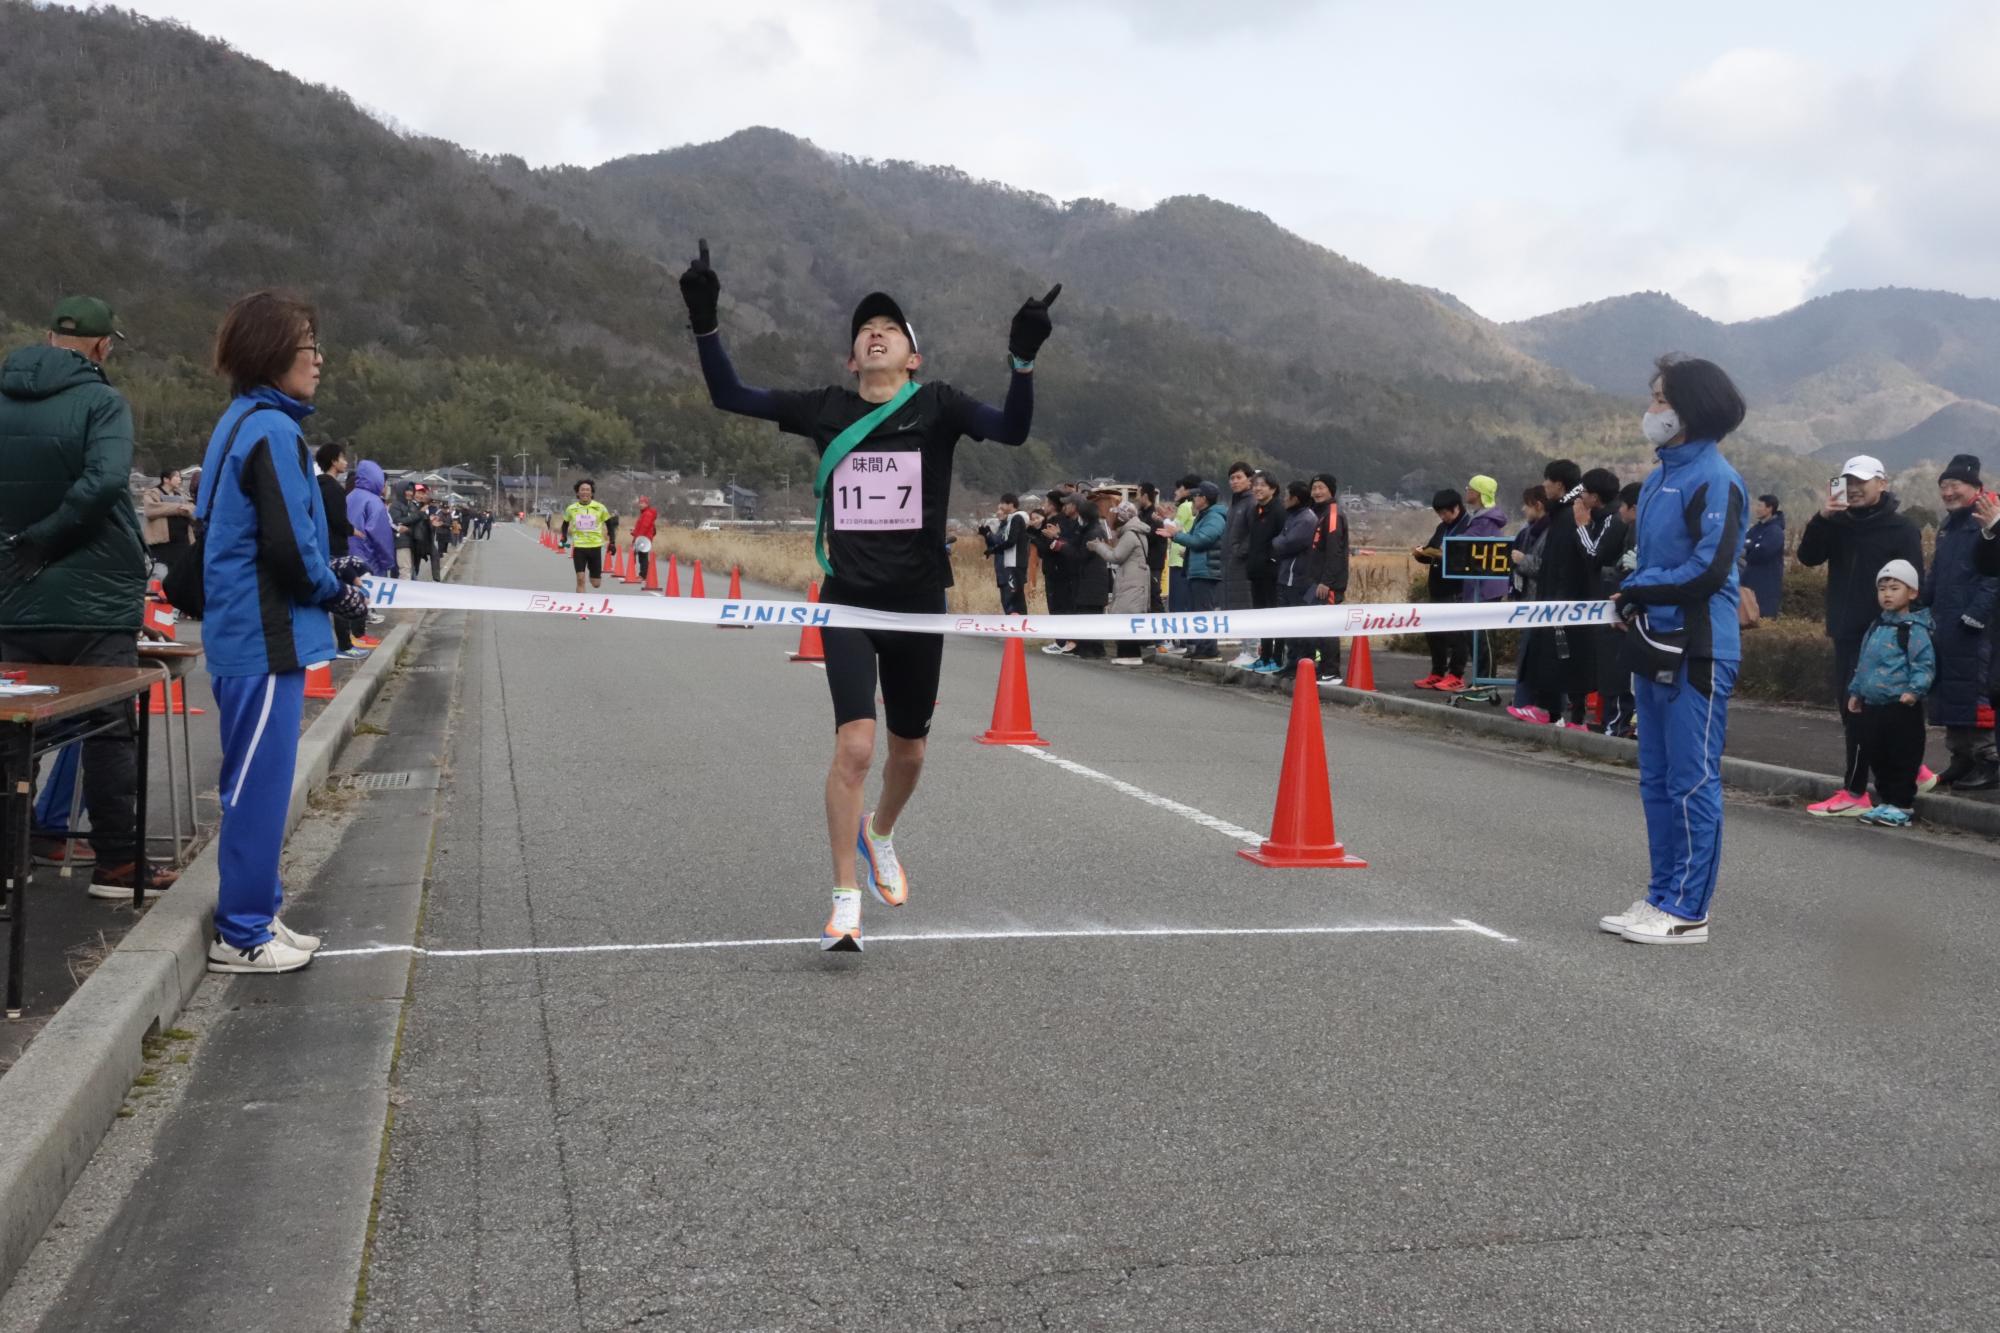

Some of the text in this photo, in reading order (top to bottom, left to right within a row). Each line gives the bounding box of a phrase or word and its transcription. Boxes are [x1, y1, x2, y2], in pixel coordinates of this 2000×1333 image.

[852, 456, 898, 473] 味間A
[720, 604, 831, 625] FINISH
[1345, 607, 1422, 631] Finish
[1508, 602, 1607, 623] FINISH
[1130, 615, 1229, 634] FINISH
